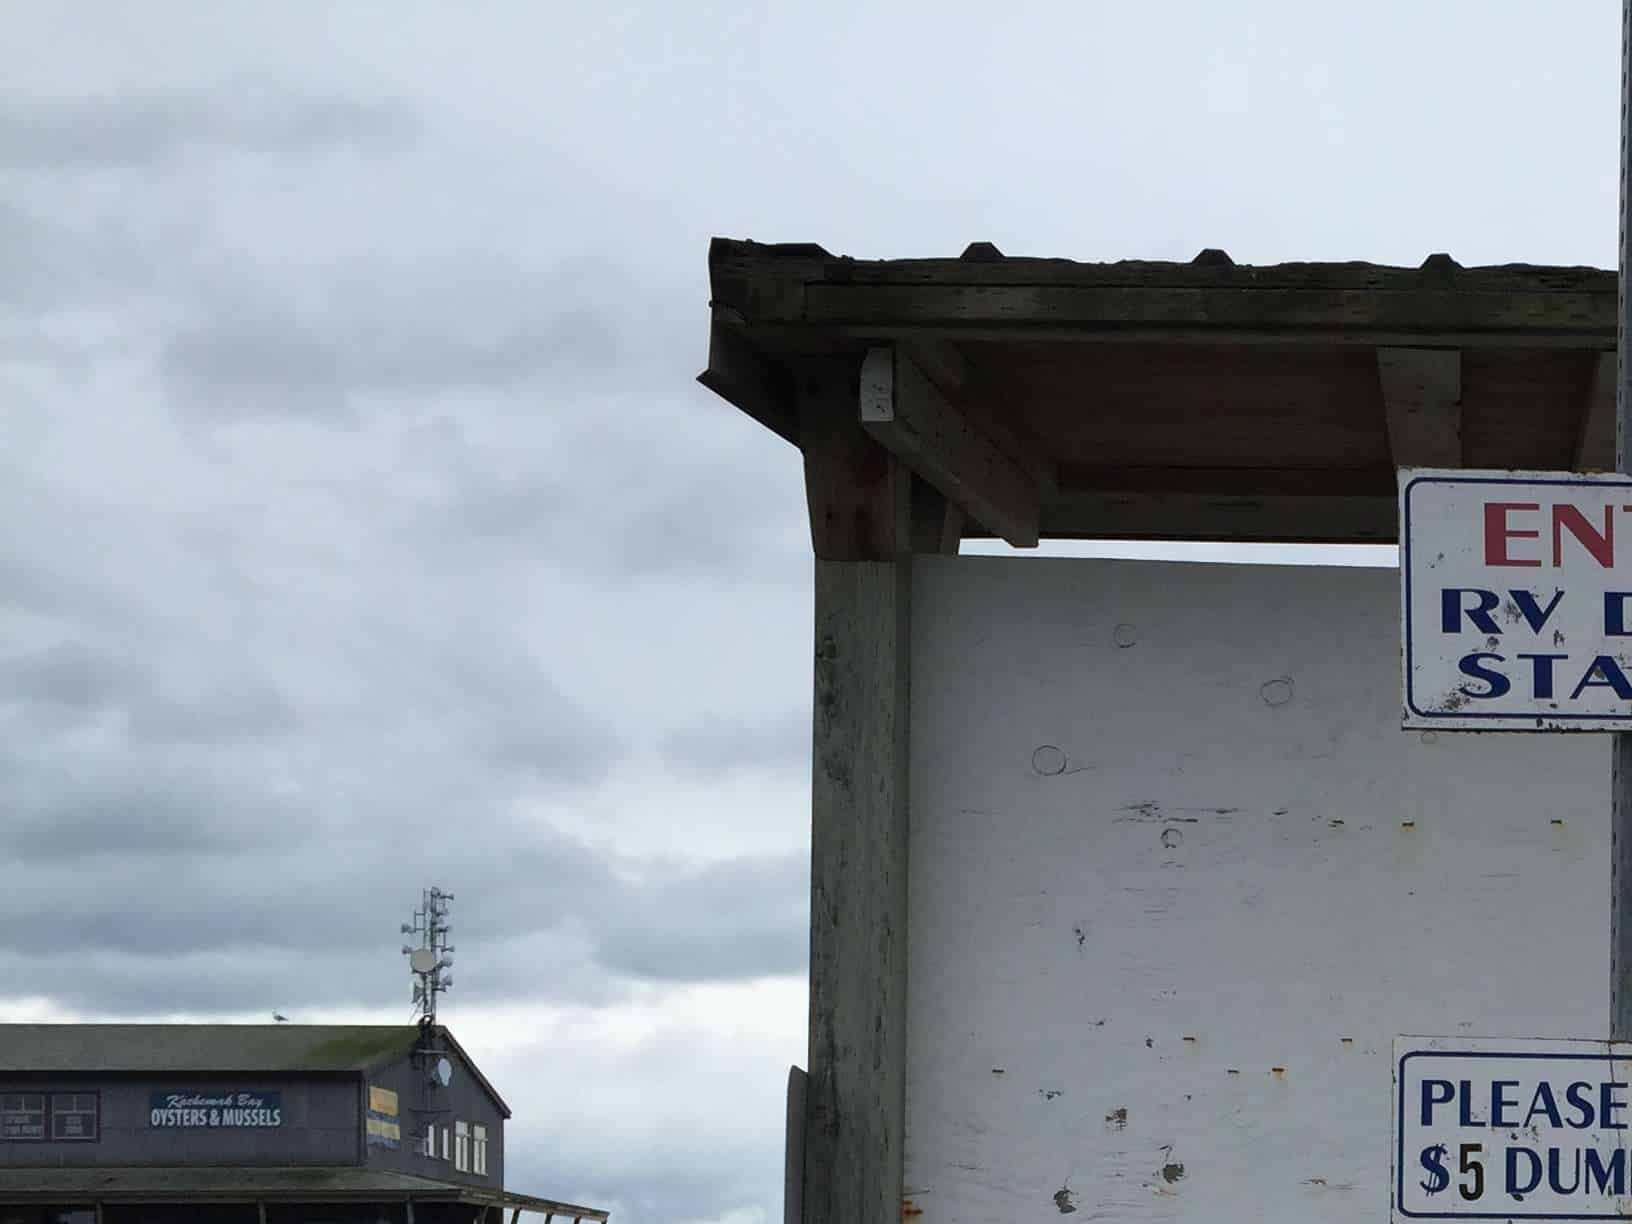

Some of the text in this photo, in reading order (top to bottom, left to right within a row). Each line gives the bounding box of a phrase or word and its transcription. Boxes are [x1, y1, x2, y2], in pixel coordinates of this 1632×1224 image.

[1441, 588, 1565, 635] RV
[151, 1109, 281, 1126] OYSTERS & MUSSELS
[237, 1094, 264, 1108] Bay
[1420, 1079, 1630, 1130] PLEASE
[1419, 1143, 1484, 1201] $5
